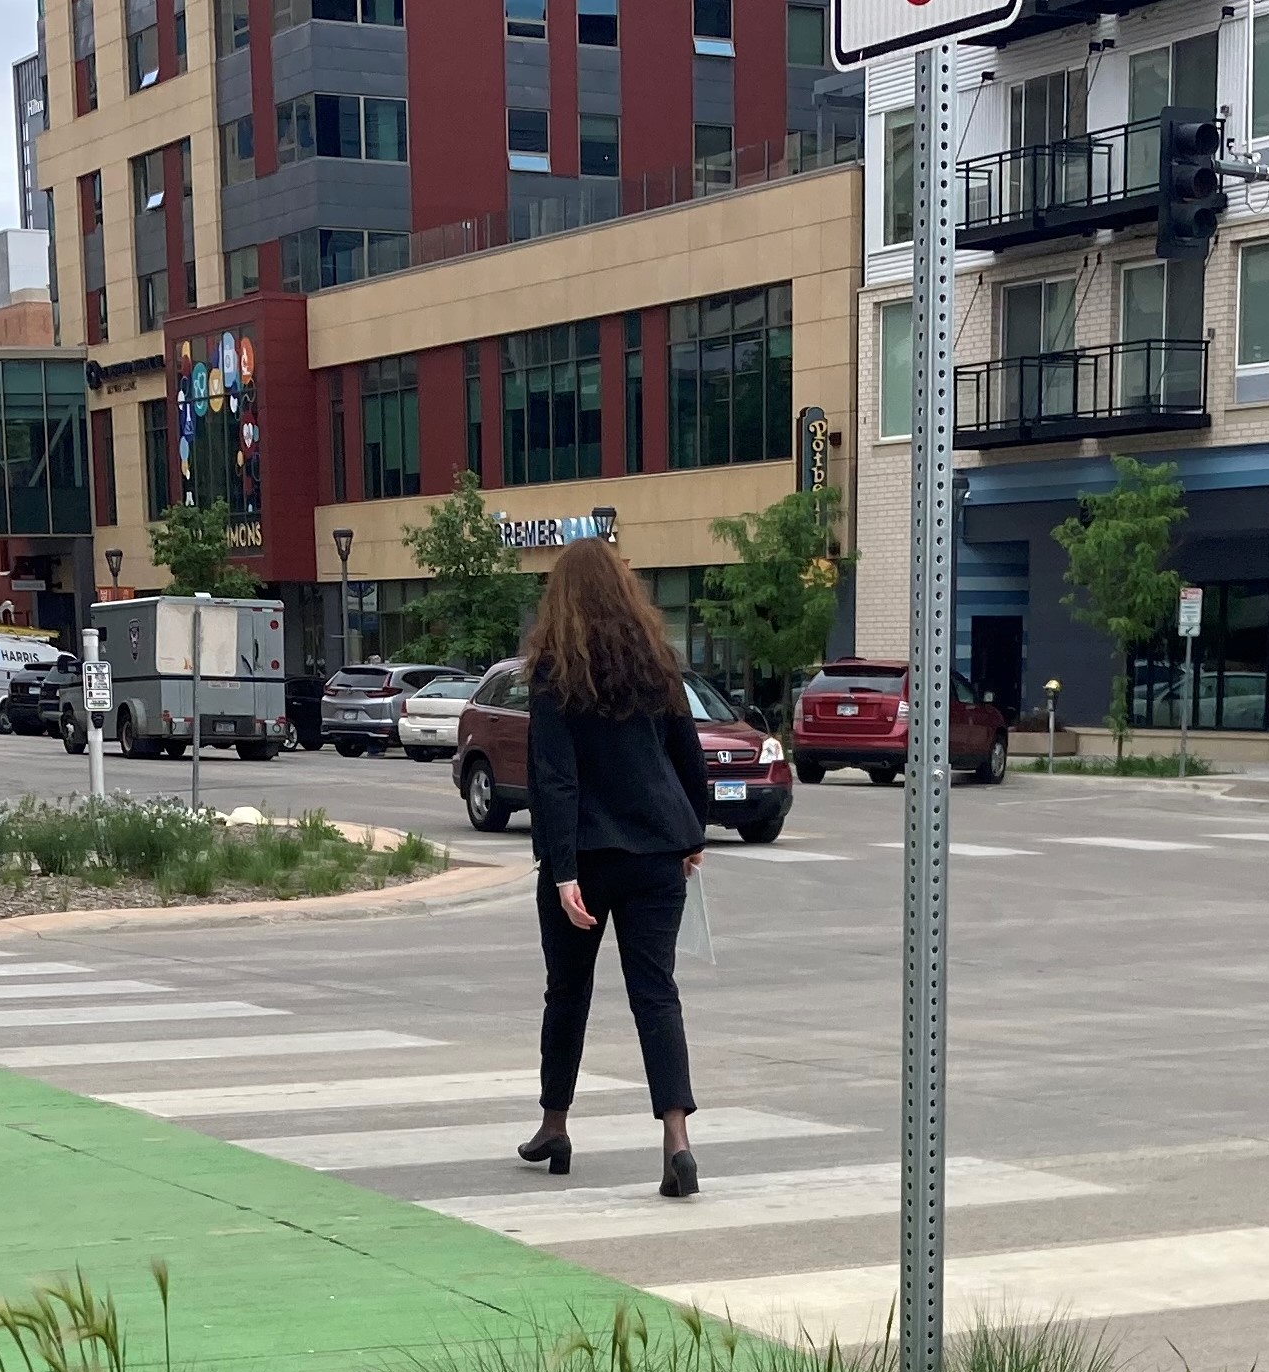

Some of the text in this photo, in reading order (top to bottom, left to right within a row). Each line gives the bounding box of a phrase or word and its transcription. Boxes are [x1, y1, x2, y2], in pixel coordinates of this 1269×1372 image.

[809, 420, 827, 530] Potbe
[220, 521, 263, 548] MONS
[1, 649, 40, 663] HARRIS
